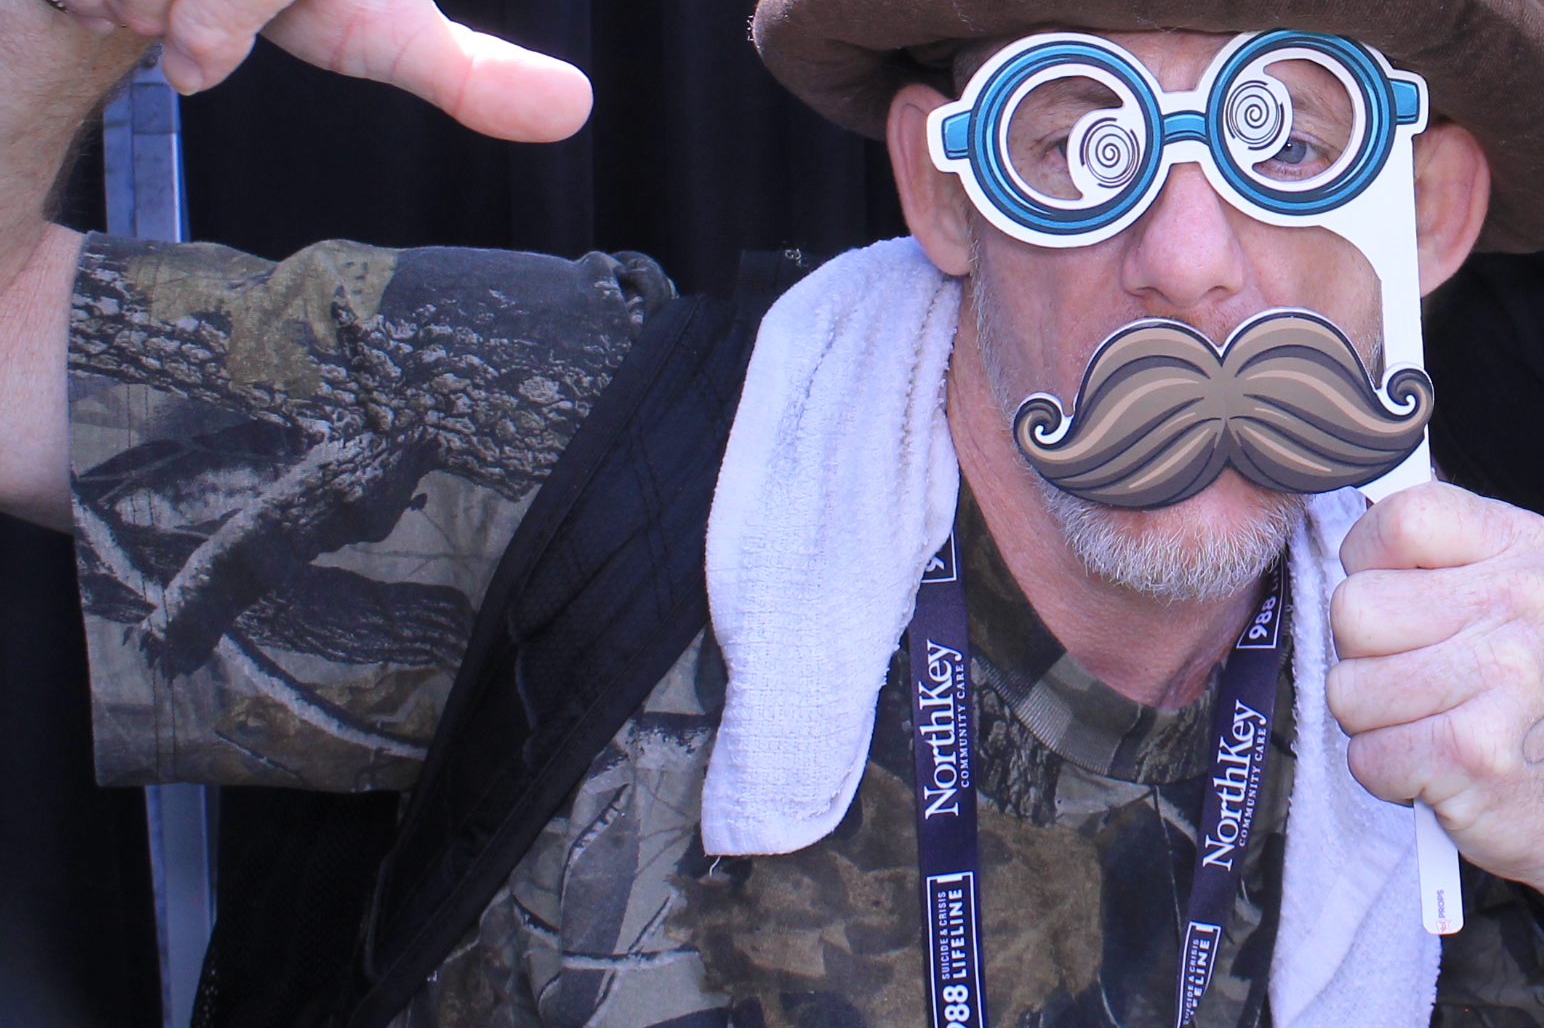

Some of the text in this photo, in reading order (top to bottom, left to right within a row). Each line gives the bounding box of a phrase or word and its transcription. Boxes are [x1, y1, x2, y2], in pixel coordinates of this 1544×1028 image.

[1248, 595, 1277, 640] 988
[918, 638, 964, 820] NorthKey
[955, 663, 970, 789] COMMUNITY CARE
[1202, 699, 1267, 871] NorthKey
[1238, 727, 1267, 847] COMMUNITY CARE
[938, 891, 950, 980] SUICIDE & CRISIS
[948, 888, 967, 979] LIFELINE
[1436, 889, 1446, 918] PROPS
[1189, 938, 1199, 973] CRISIS
[1190, 938, 1210, 1016] FELINE
